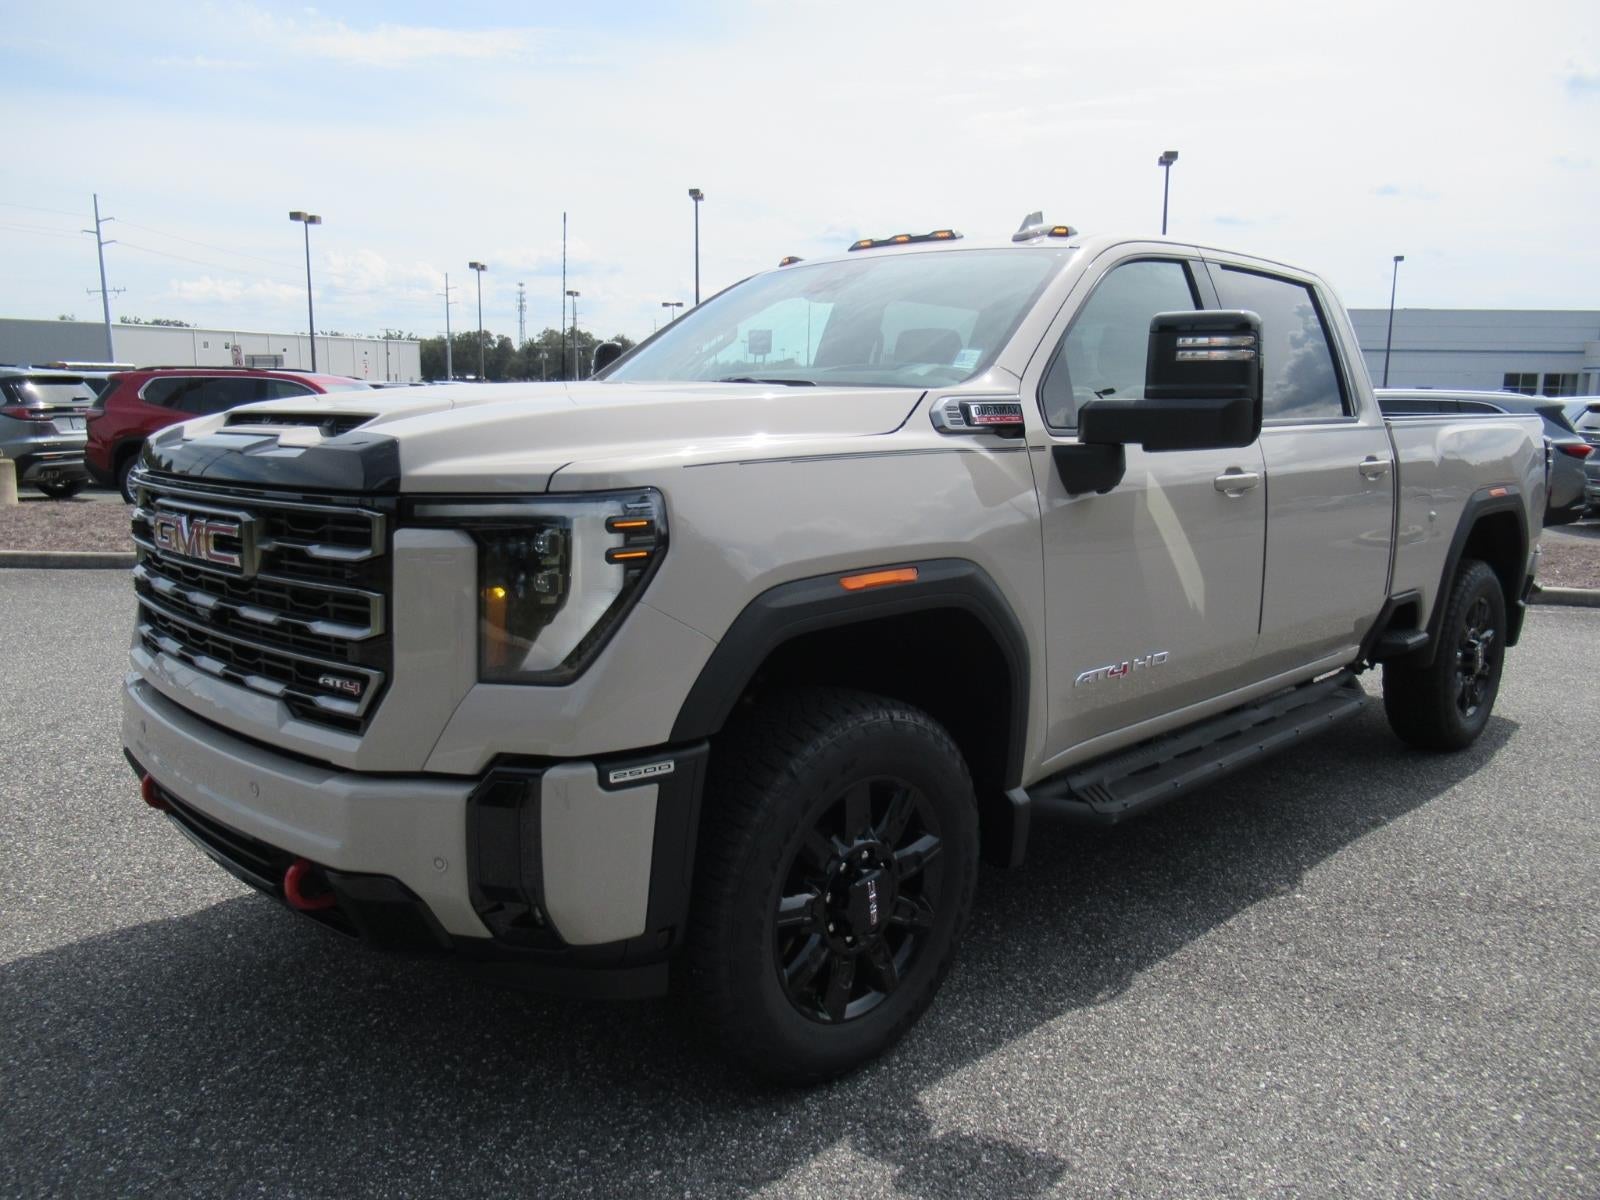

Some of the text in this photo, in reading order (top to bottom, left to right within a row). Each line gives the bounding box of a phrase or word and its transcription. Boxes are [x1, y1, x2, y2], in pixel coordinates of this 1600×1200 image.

[974, 405, 1019, 416] DURAMAX
[153, 511, 241, 568] GMC
[1074, 651, 1168, 688] AT4 HD
[318, 676, 361, 696] AT4
[612, 763, 672, 780] 2500
